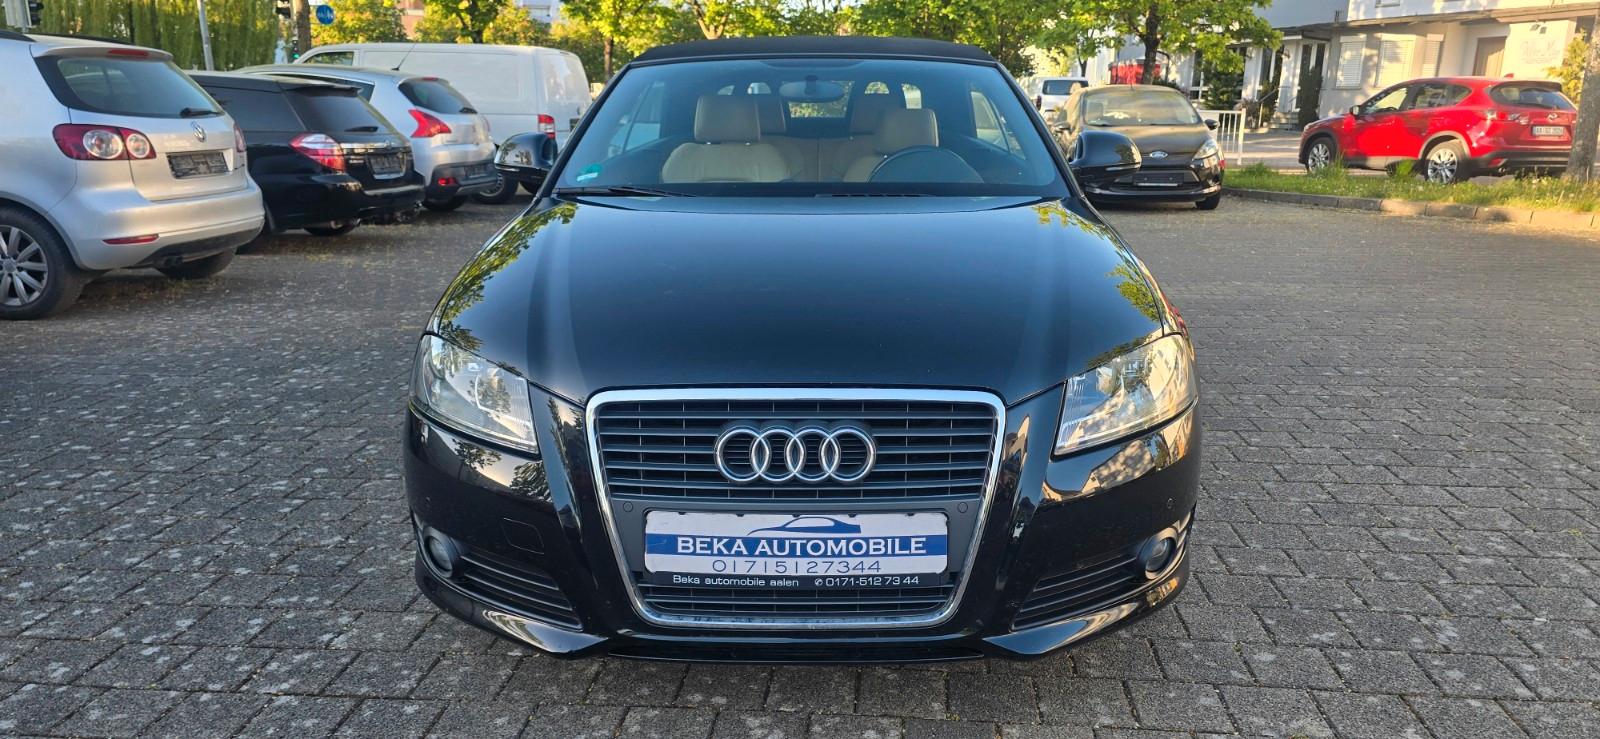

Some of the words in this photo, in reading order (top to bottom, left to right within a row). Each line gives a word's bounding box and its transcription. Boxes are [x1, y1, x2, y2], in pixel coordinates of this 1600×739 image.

[677, 536, 749, 555] BEKA
[754, 537, 927, 556] AUTOMOBILE
[712, 559, 882, 574] 01715127344
[673, 574, 700, 584] Beka
[704, 575, 766, 587] automobile
[769, 576, 799, 587] aalen
[825, 576, 882, 587] 0171-512
[884, 576, 900, 586] 73
[902, 575, 920, 586] 44
